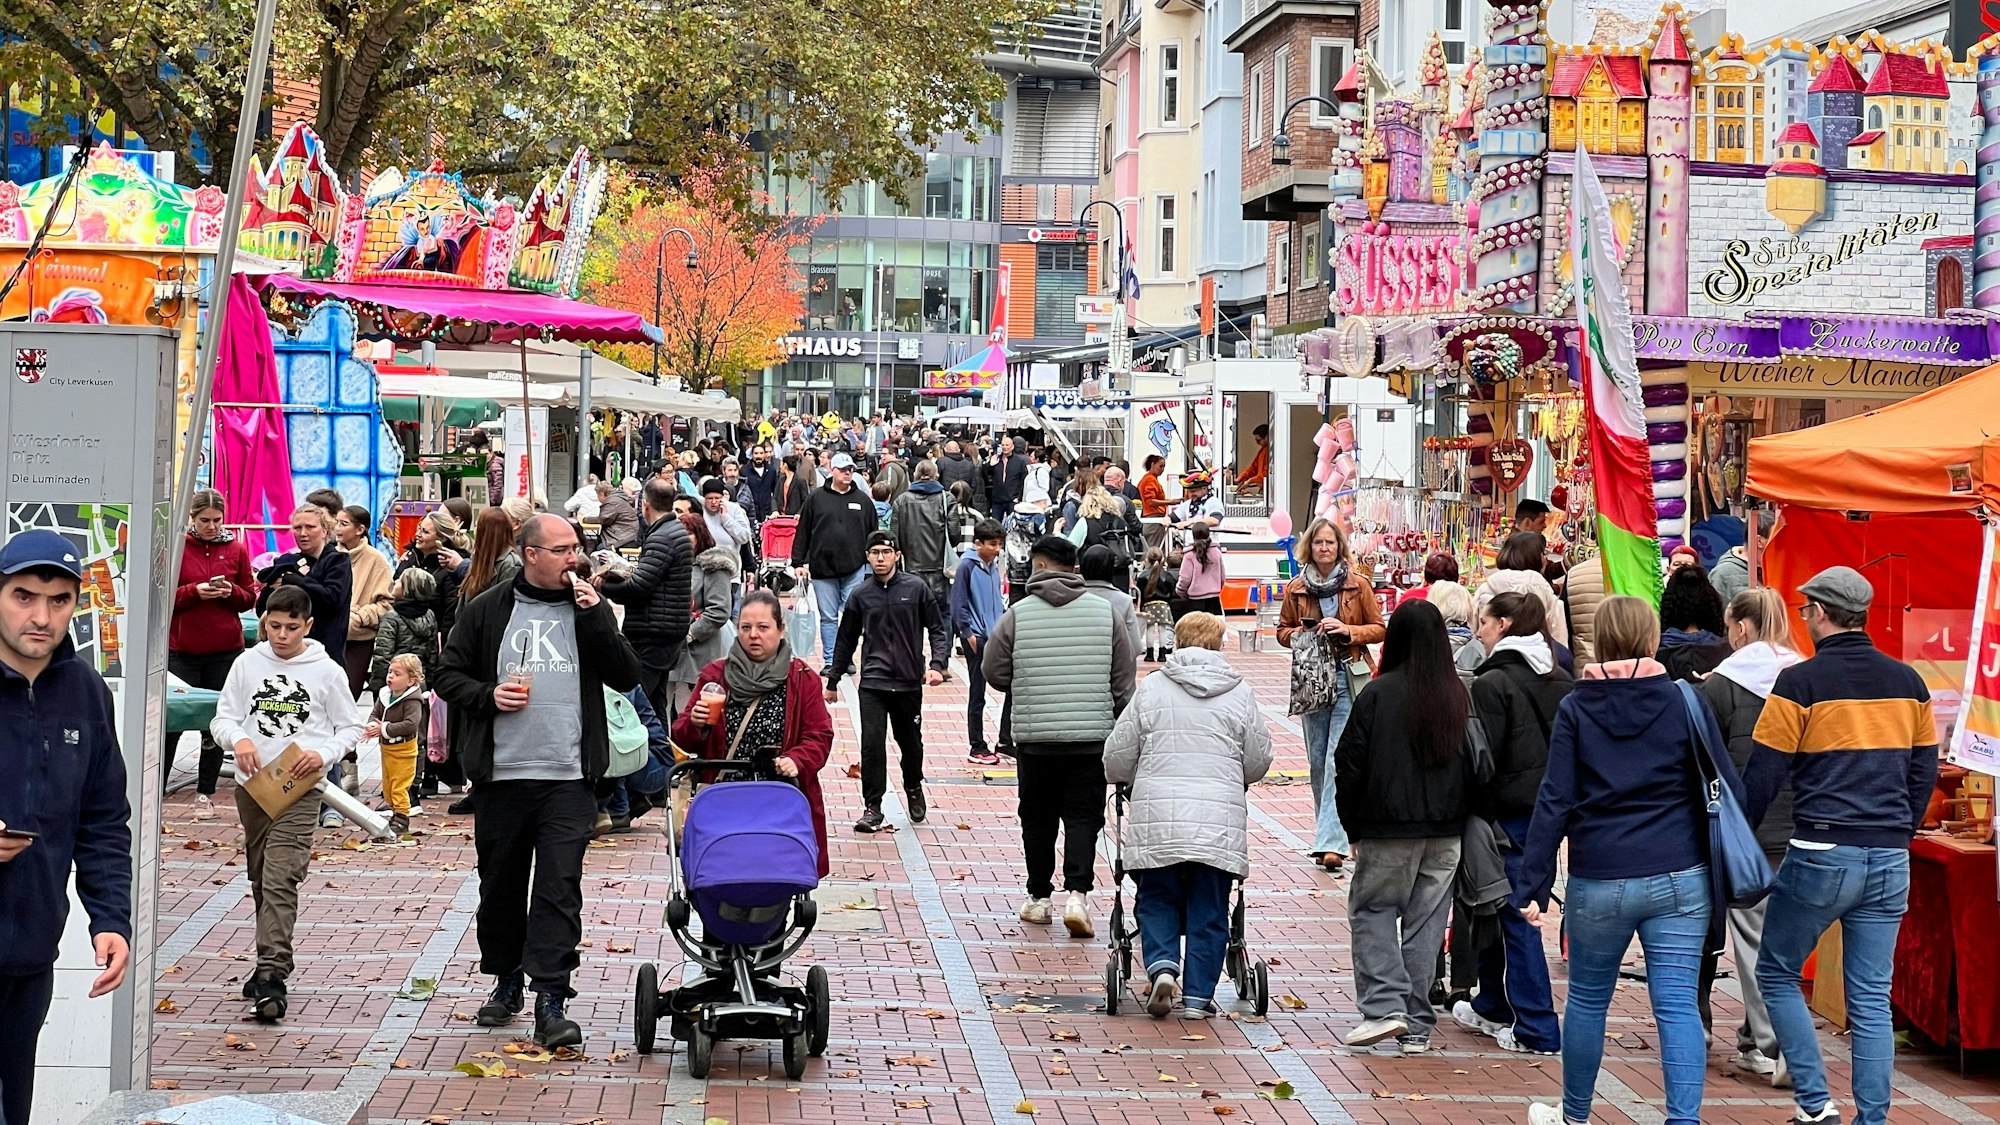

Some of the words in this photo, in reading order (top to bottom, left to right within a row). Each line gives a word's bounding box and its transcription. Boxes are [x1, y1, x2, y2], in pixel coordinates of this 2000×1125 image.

[1702, 212, 1939, 306] Spezialitäten
[1753, 236, 1810, 268] Süße
[45, 258, 109, 283] einmal
[776, 336, 862, 357] ATHAUS
[1632, 323, 1682, 353] Pop
[1692, 326, 1749, 355] Corn
[1809, 321, 1961, 355] Zuckerwatte
[1132, 345, 1156, 368] endy
[1703, 360, 1817, 384] Wiener
[49, 378, 66, 386] City
[67, 378, 114, 387] Leverkusen
[12, 434, 101, 448] Wiesdorfer
[12, 451, 51, 464] Platz
[12, 474, 29, 484] Die
[32, 474, 91, 484] Luminaden
[549, 661, 578, 673] Klein
[257, 700, 301, 714] JACK&JONES
[1972, 744, 1995, 756] NABU
[281, 780, 296, 794] A2
